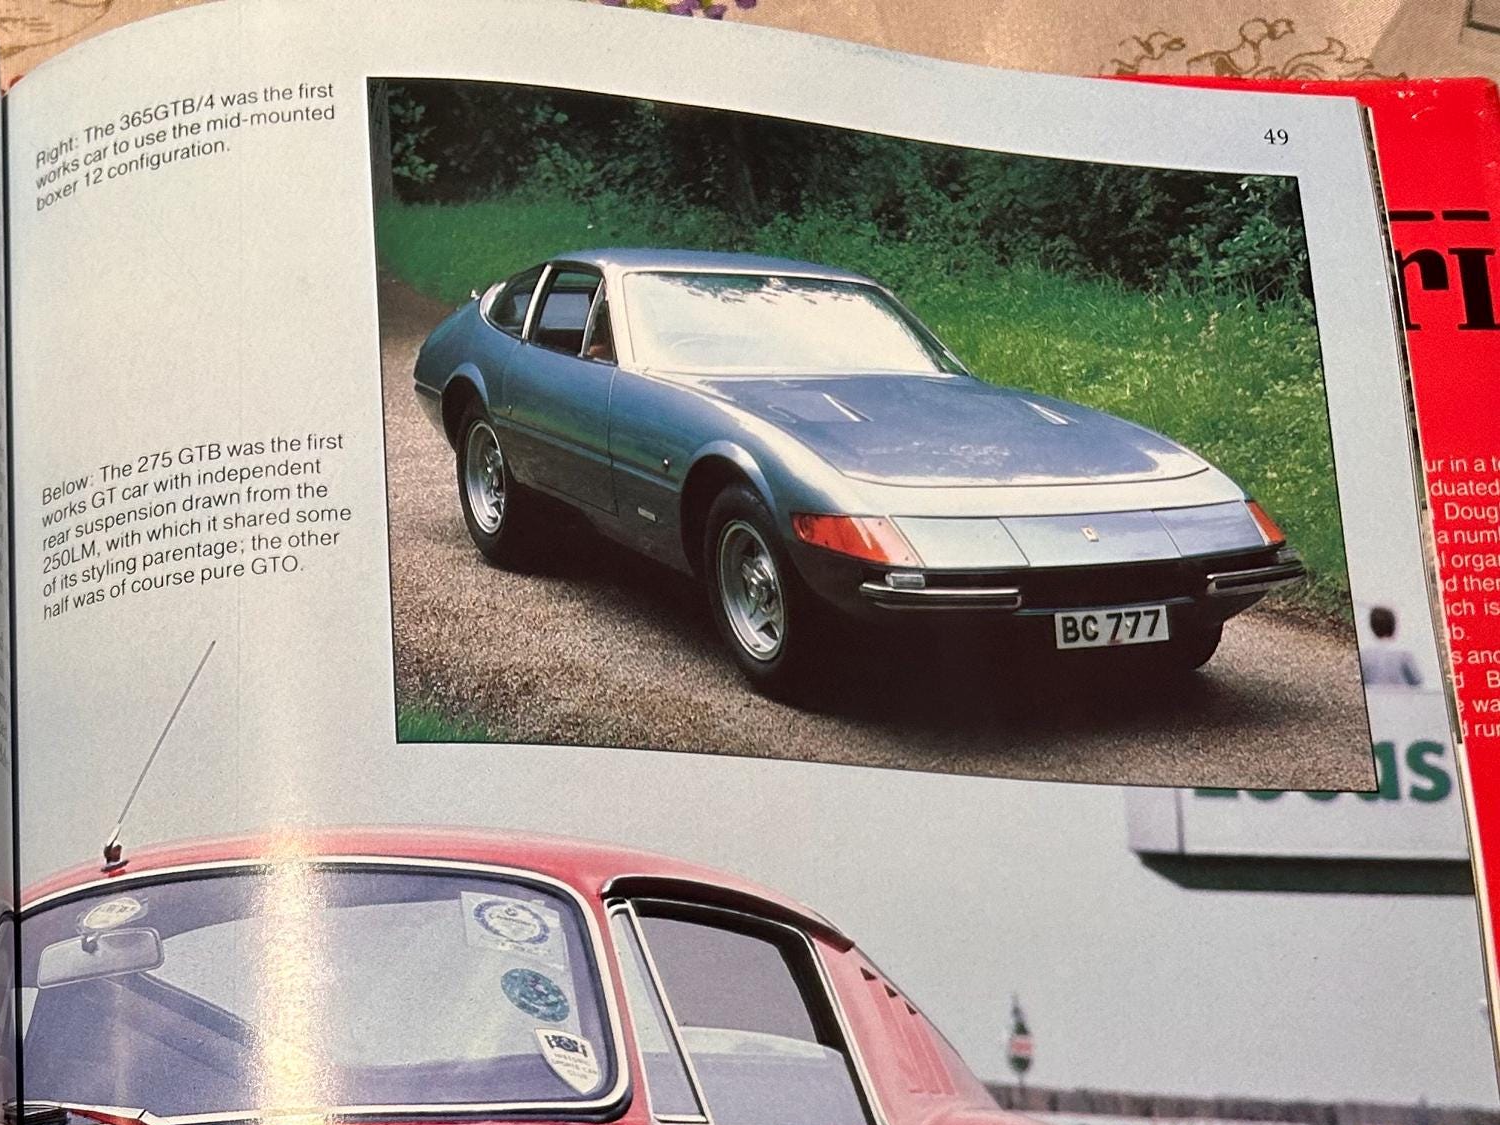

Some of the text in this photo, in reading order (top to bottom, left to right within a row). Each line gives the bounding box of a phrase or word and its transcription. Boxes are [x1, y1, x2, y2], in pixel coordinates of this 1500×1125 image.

[36, 83, 334, 169] Right: The 365GTB/4 was the first
[36, 104, 335, 190] works car to use the mid-mounted
[1263, 127, 1289, 147] 49
[36, 140, 230, 210] boxer 12 configuration.
[42, 433, 344, 506] Below: The 275 GTB was the first
[42, 458, 321, 527] works GT car with independent
[43, 482, 328, 551] rear suspension drawn from the
[43, 507, 352, 573] 250LM, with which it shared some
[43, 530, 340, 596] of its styling parentage; the other
[43, 554, 305, 620] half was of course pure GTO.
[1061, 608, 1161, 644] BC 777
